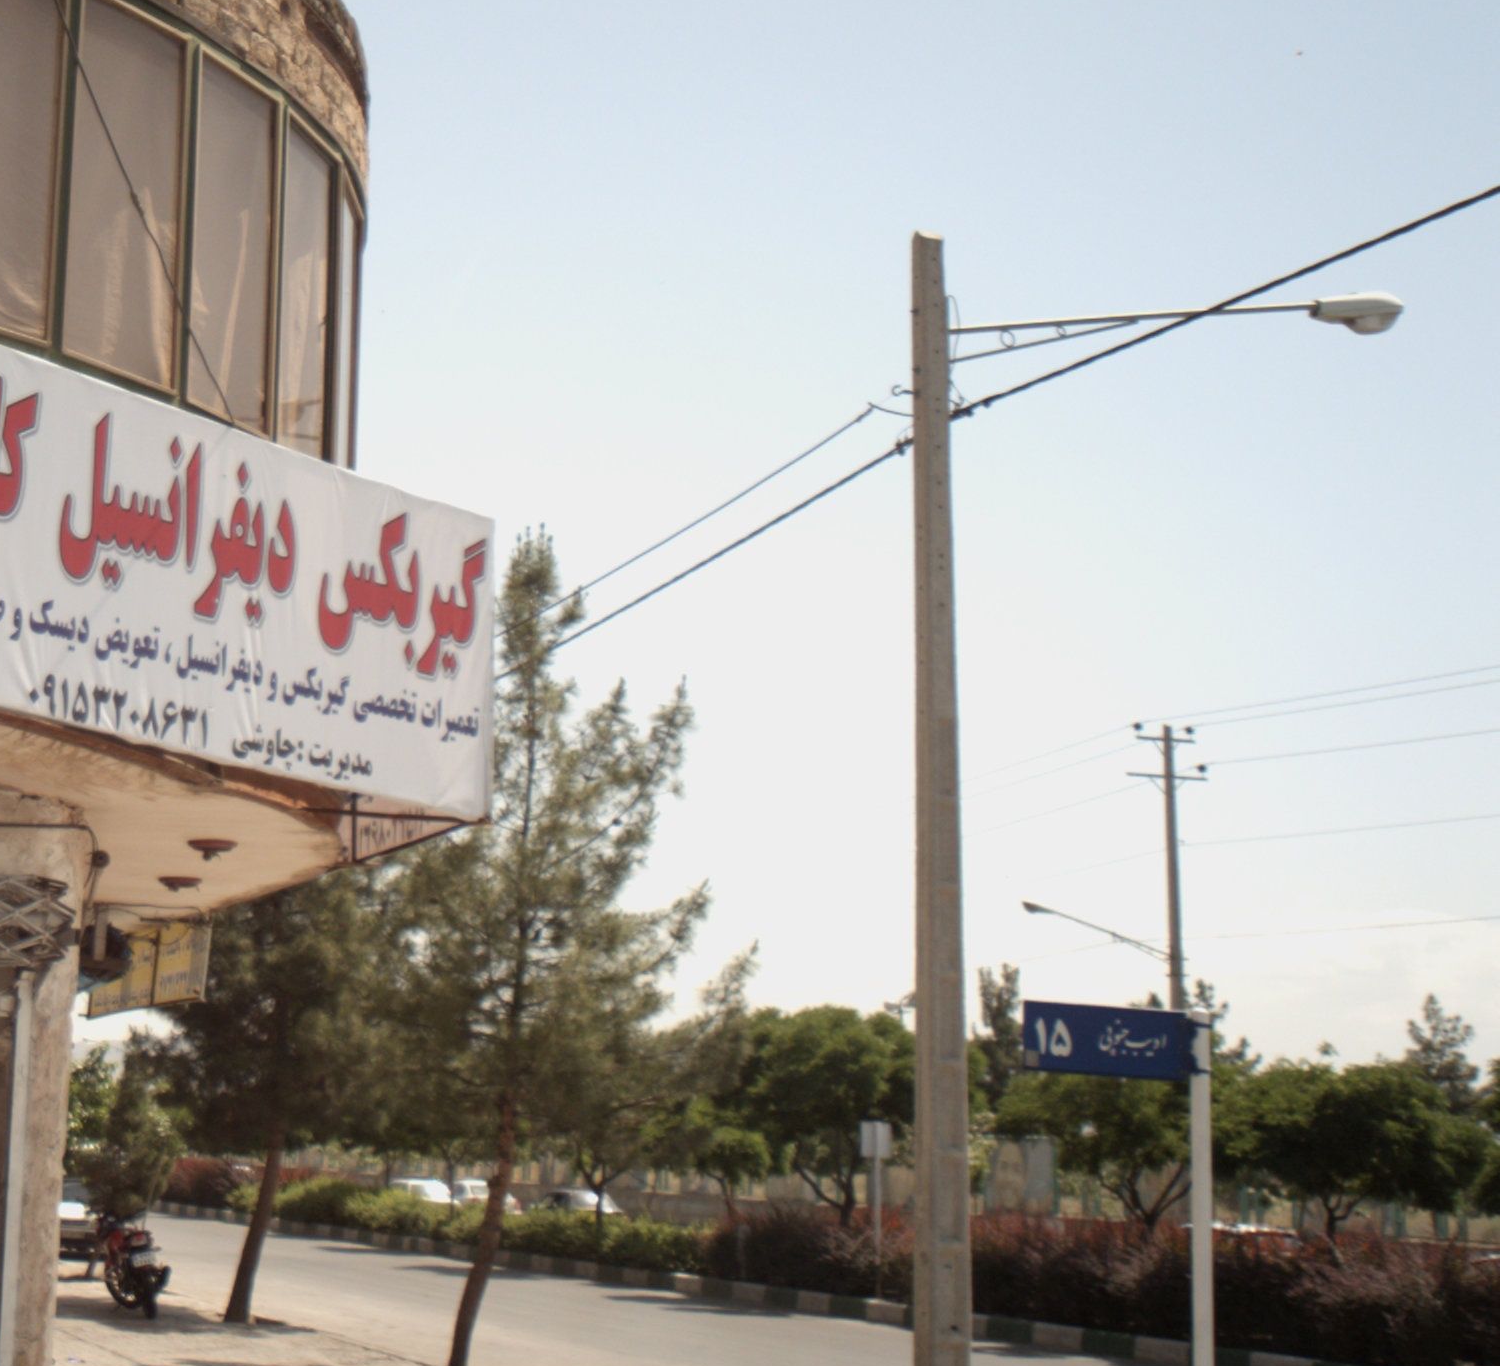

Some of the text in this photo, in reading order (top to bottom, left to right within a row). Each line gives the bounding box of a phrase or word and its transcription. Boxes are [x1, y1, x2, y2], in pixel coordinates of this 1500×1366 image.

[59, 411, 296, 625] دیفرانسیل
[318, 512, 486, 675] گیربکس
[9, 607, 23, 641] و
[29, 599, 90, 652] دیسک
[95, 617, 160, 669] تعویض
[176, 634, 264, 693] دیفرانسیل
[267, 671, 278, 702] و
[28, 673, 209, 749] ۰۹۱۵۳۲۰۸۶۳۱
[282, 667, 350, 716] گیربکس
[352, 689, 418, 724] تخصصی
[421, 698, 480, 742] تعمیرات
[1034, 1016, 1074, 1058] ۱۵
[1124, 1033, 1168, 1058] ادیب
